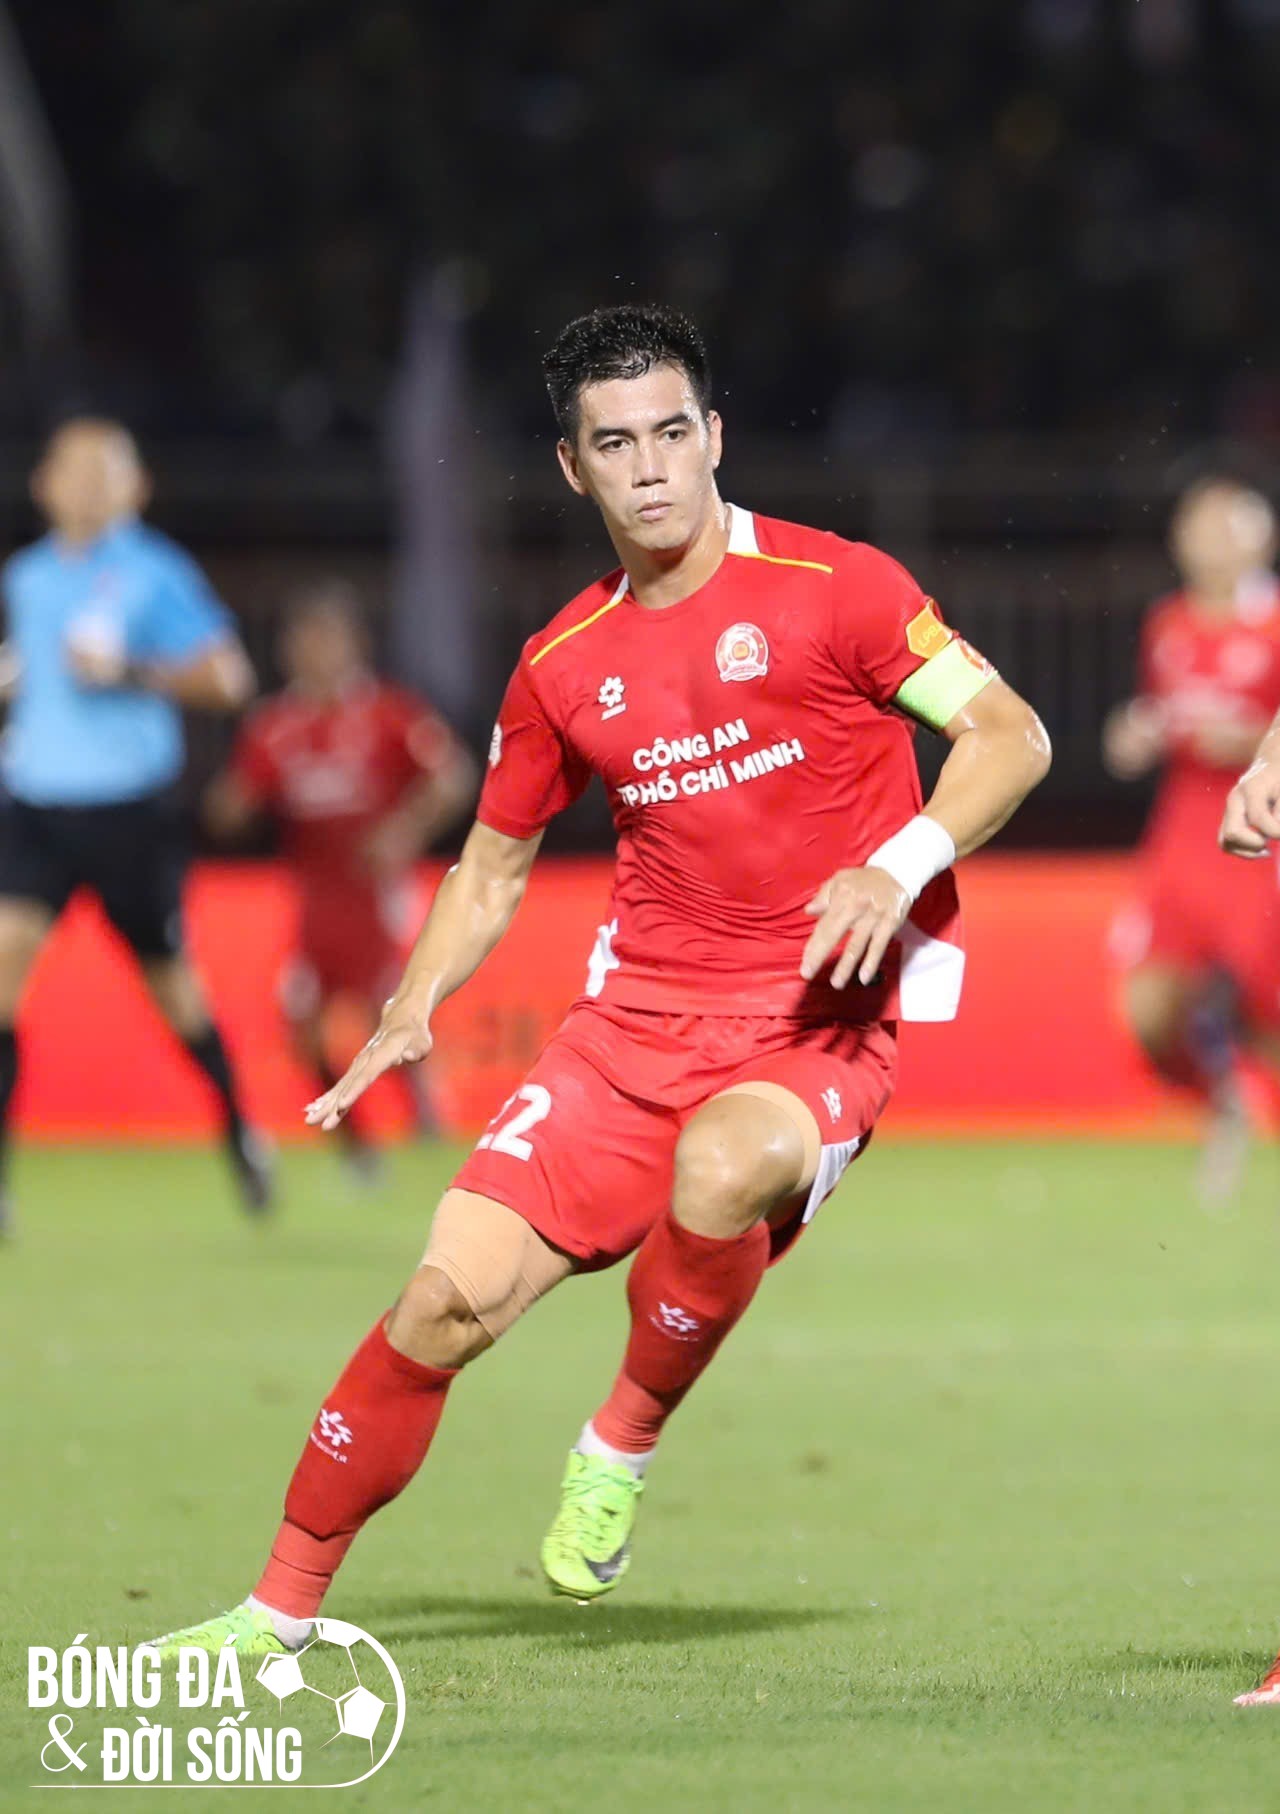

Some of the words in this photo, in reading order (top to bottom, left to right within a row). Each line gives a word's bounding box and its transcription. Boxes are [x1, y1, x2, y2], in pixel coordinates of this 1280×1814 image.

[633, 733, 711, 771] CÔNG
[713, 718, 750, 752] AN
[680, 759, 729, 796] CHÍ
[729, 738, 805, 783] MINH
